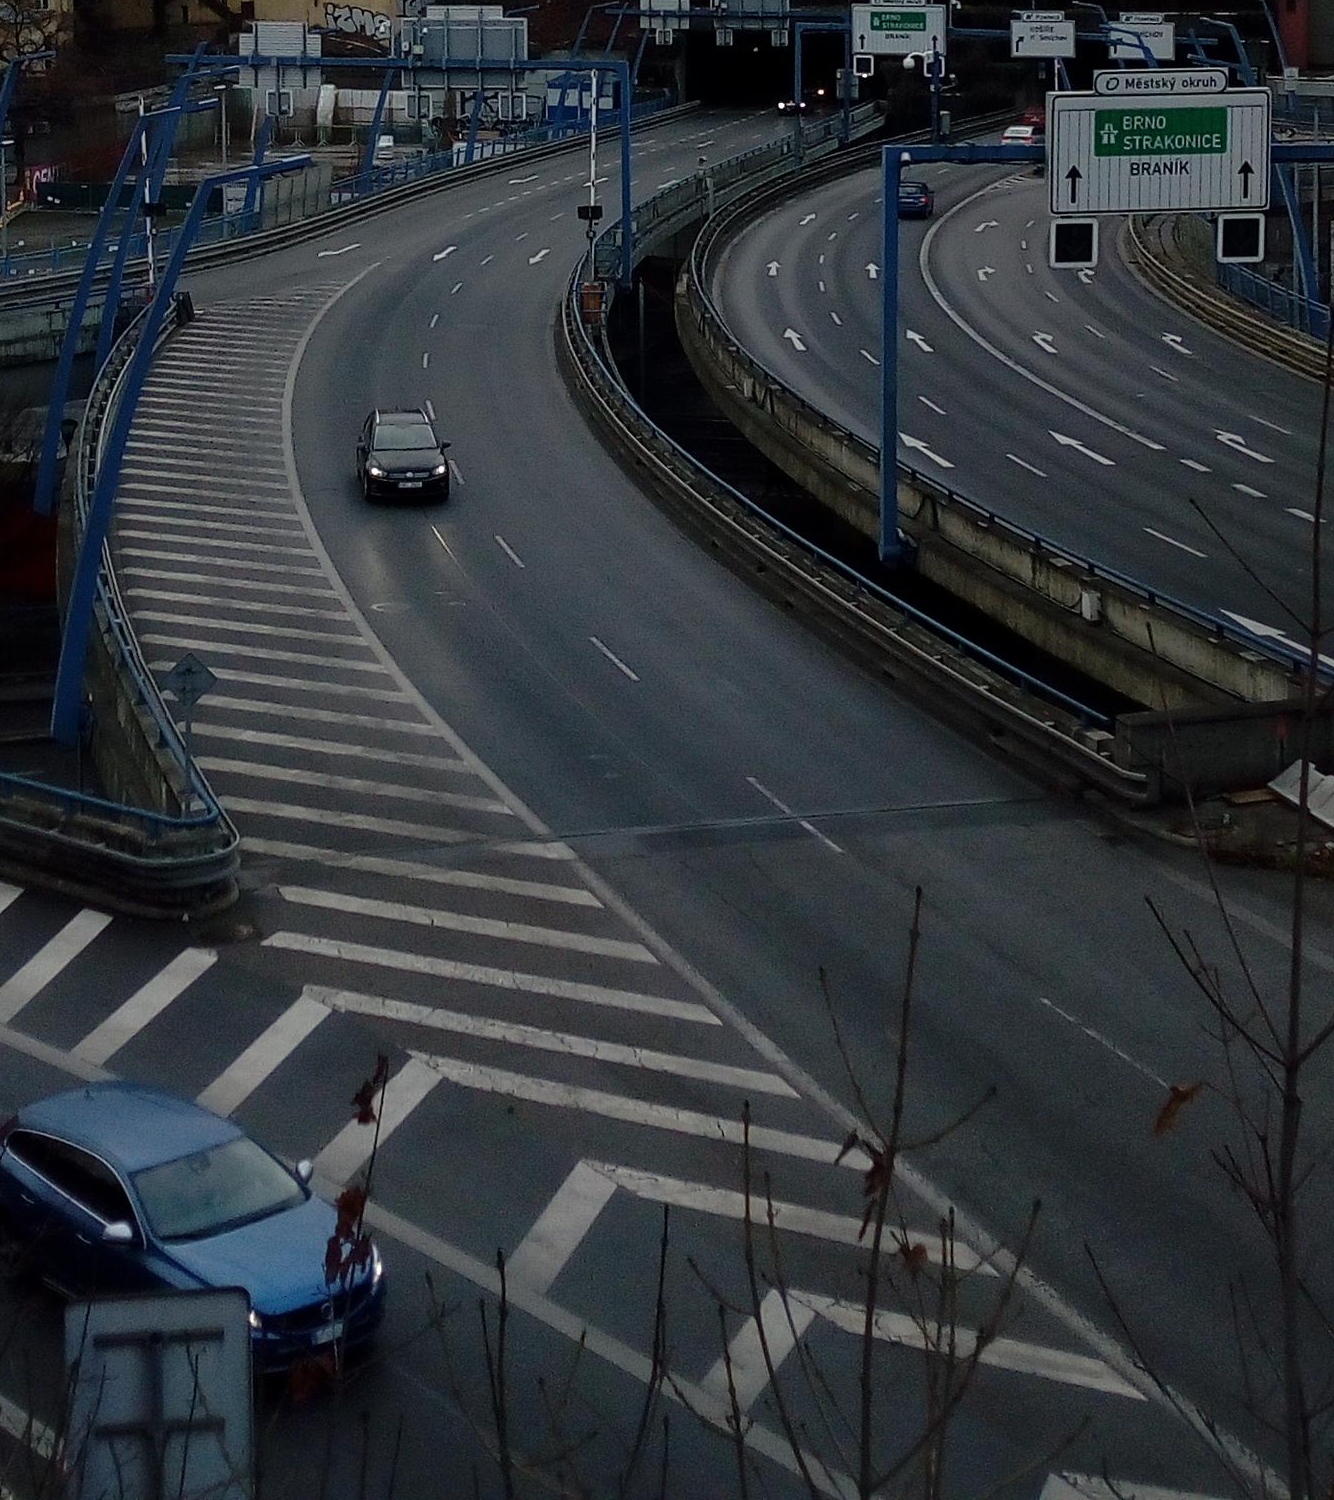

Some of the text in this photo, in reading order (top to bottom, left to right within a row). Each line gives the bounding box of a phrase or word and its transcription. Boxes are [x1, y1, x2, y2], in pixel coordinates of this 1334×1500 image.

[1124, 76, 1217, 92] Městský okruh
[1122, 115, 1167, 130] BRNO
[1122, 133, 1222, 151] STRAKONICE
[1129, 157, 1190, 176] BRANÍK
